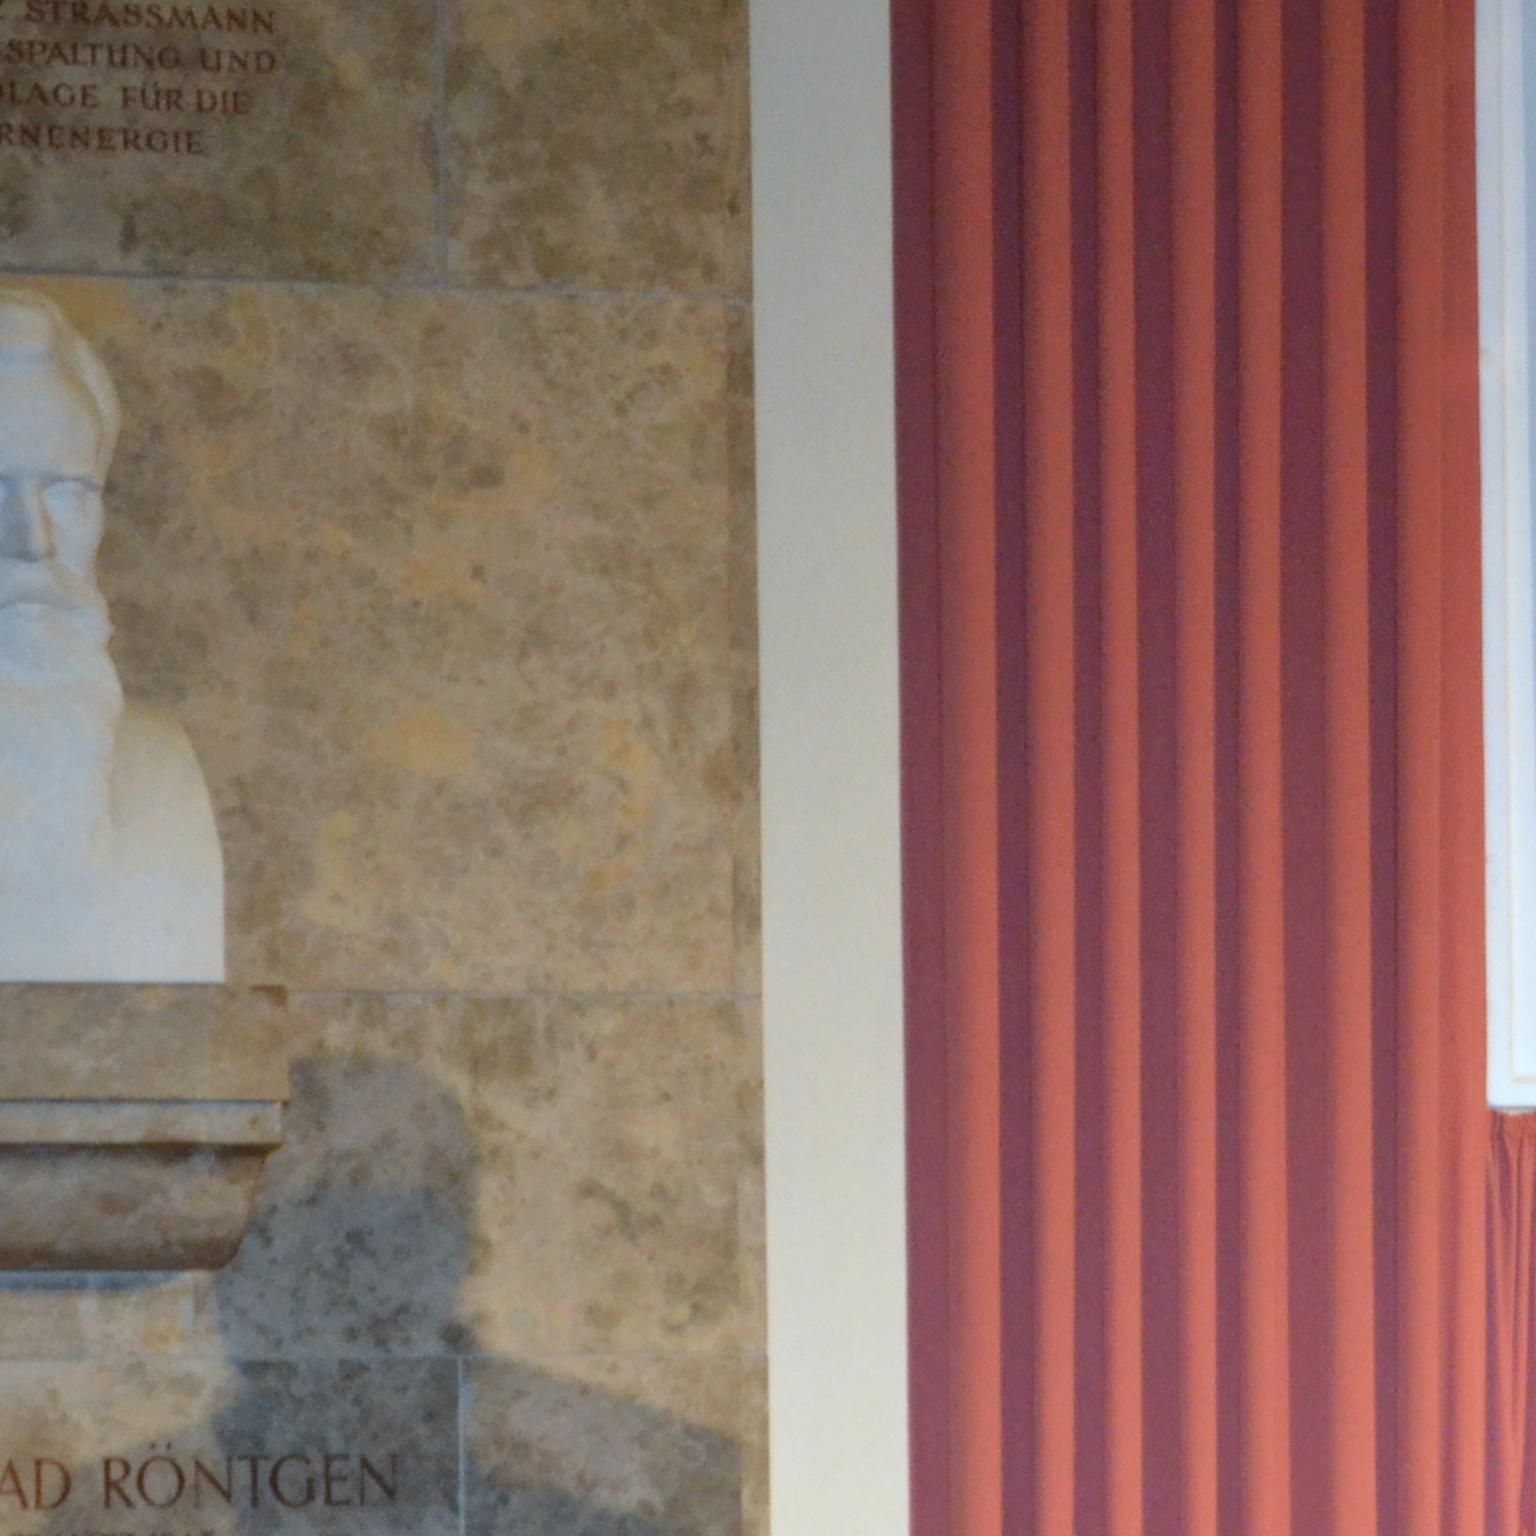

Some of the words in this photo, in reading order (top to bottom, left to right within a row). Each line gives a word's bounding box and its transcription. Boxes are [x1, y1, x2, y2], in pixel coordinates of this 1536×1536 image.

[25, 0, 277, 35] STRASSMANN
[6, 38, 182, 71] SPALTUNG
[200, 47, 278, 75] UND
[121, 81, 185, 113] FÜR
[195, 88, 251, 116] DIE
[0, 1456, 72, 1511] AD
[102, 1441, 401, 1511] RÖNTGEN
